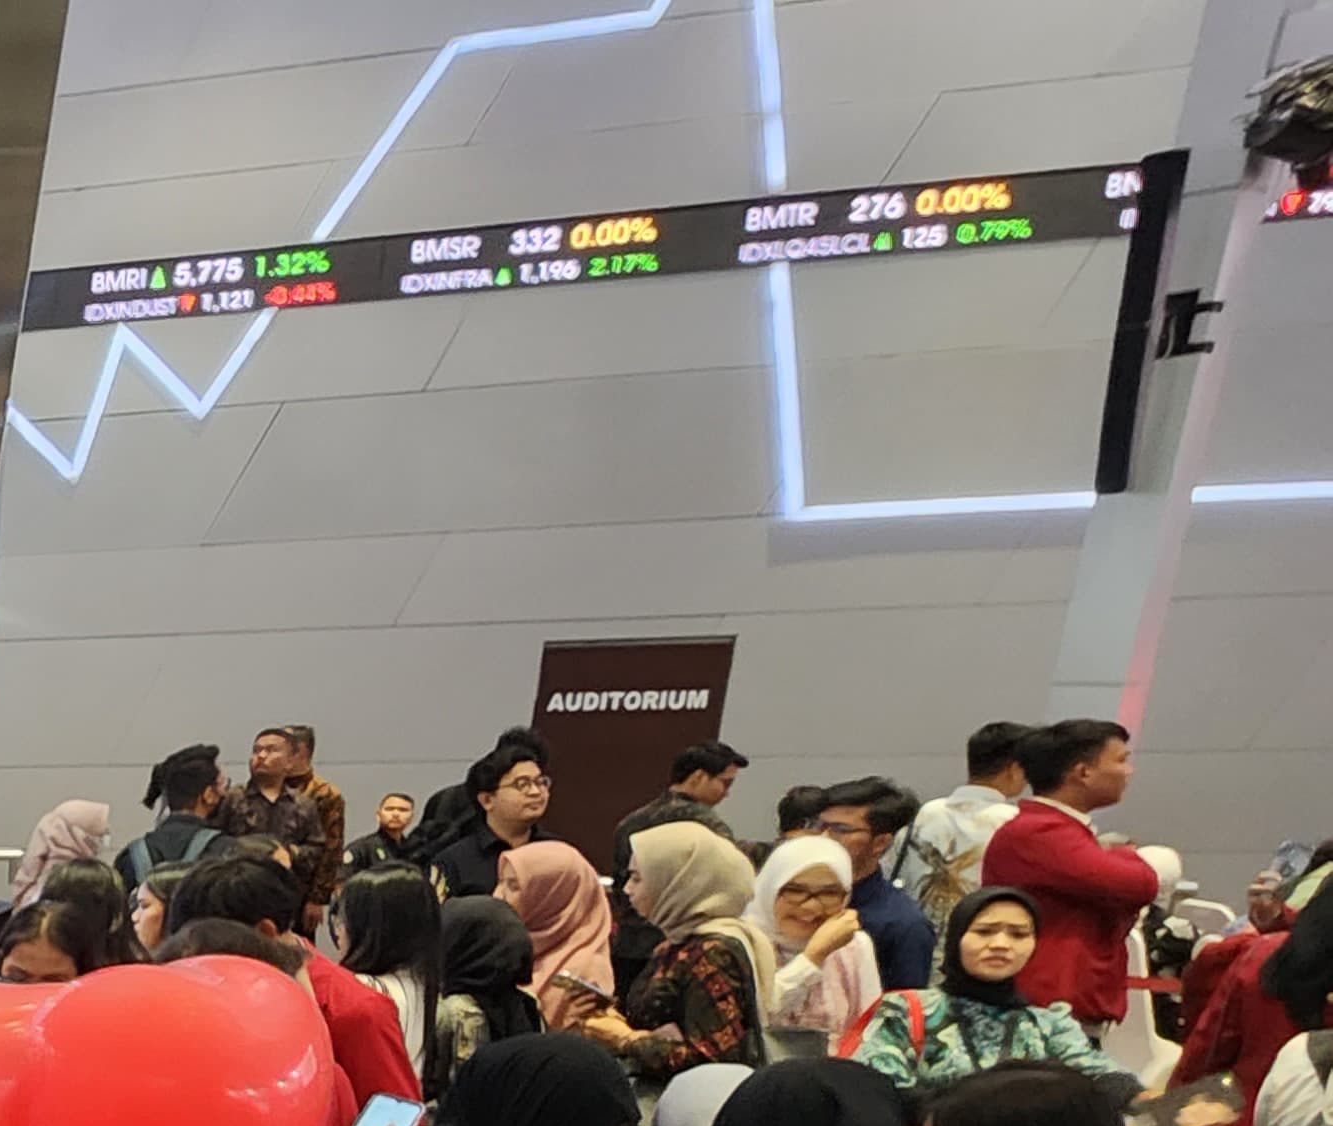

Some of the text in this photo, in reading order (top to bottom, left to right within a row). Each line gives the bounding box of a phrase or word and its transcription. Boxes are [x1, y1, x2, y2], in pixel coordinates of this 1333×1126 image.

[745, 183, 1012, 231] BMTR 276 0.00%
[410, 217, 658, 264] BMSR 332 0.00%
[901, 225, 948, 249] 125
[90, 267, 148, 294] BMRI
[254, 250, 331, 279] 1.32%
[84, 296, 178, 322] IDXINDUST
[546, 689, 710, 713] AUDITORIUM
